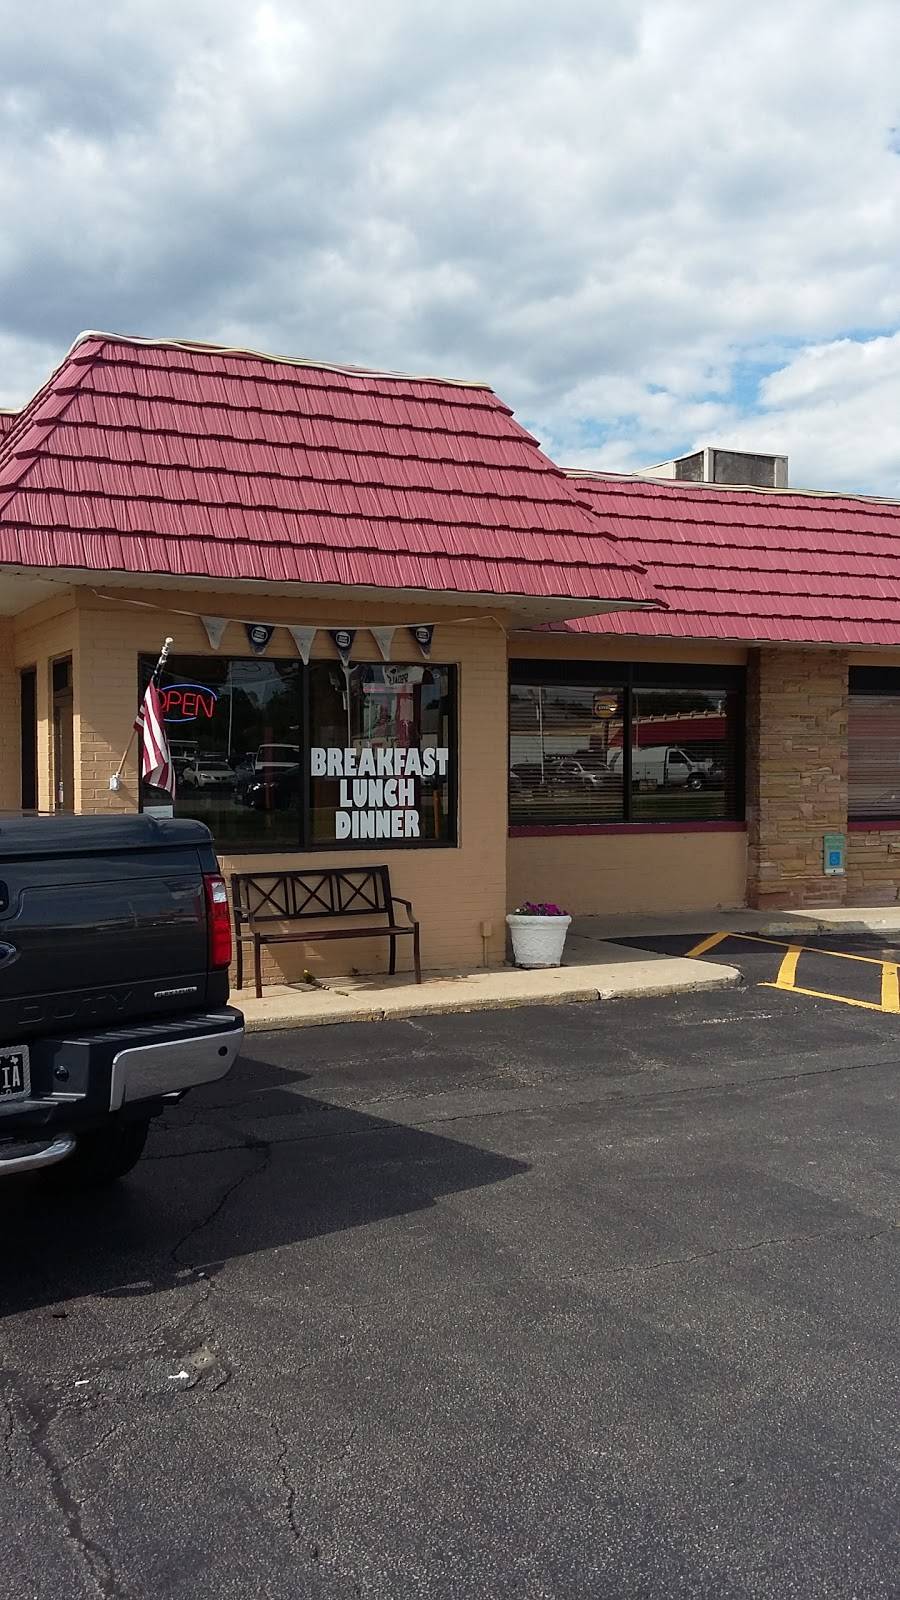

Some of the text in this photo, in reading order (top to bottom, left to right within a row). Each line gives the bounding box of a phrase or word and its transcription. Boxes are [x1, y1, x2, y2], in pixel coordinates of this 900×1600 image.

[310, 747, 449, 777] BREAKFAST
[340, 778, 415, 808] LUNCH
[335, 810, 420, 840] DINNER
